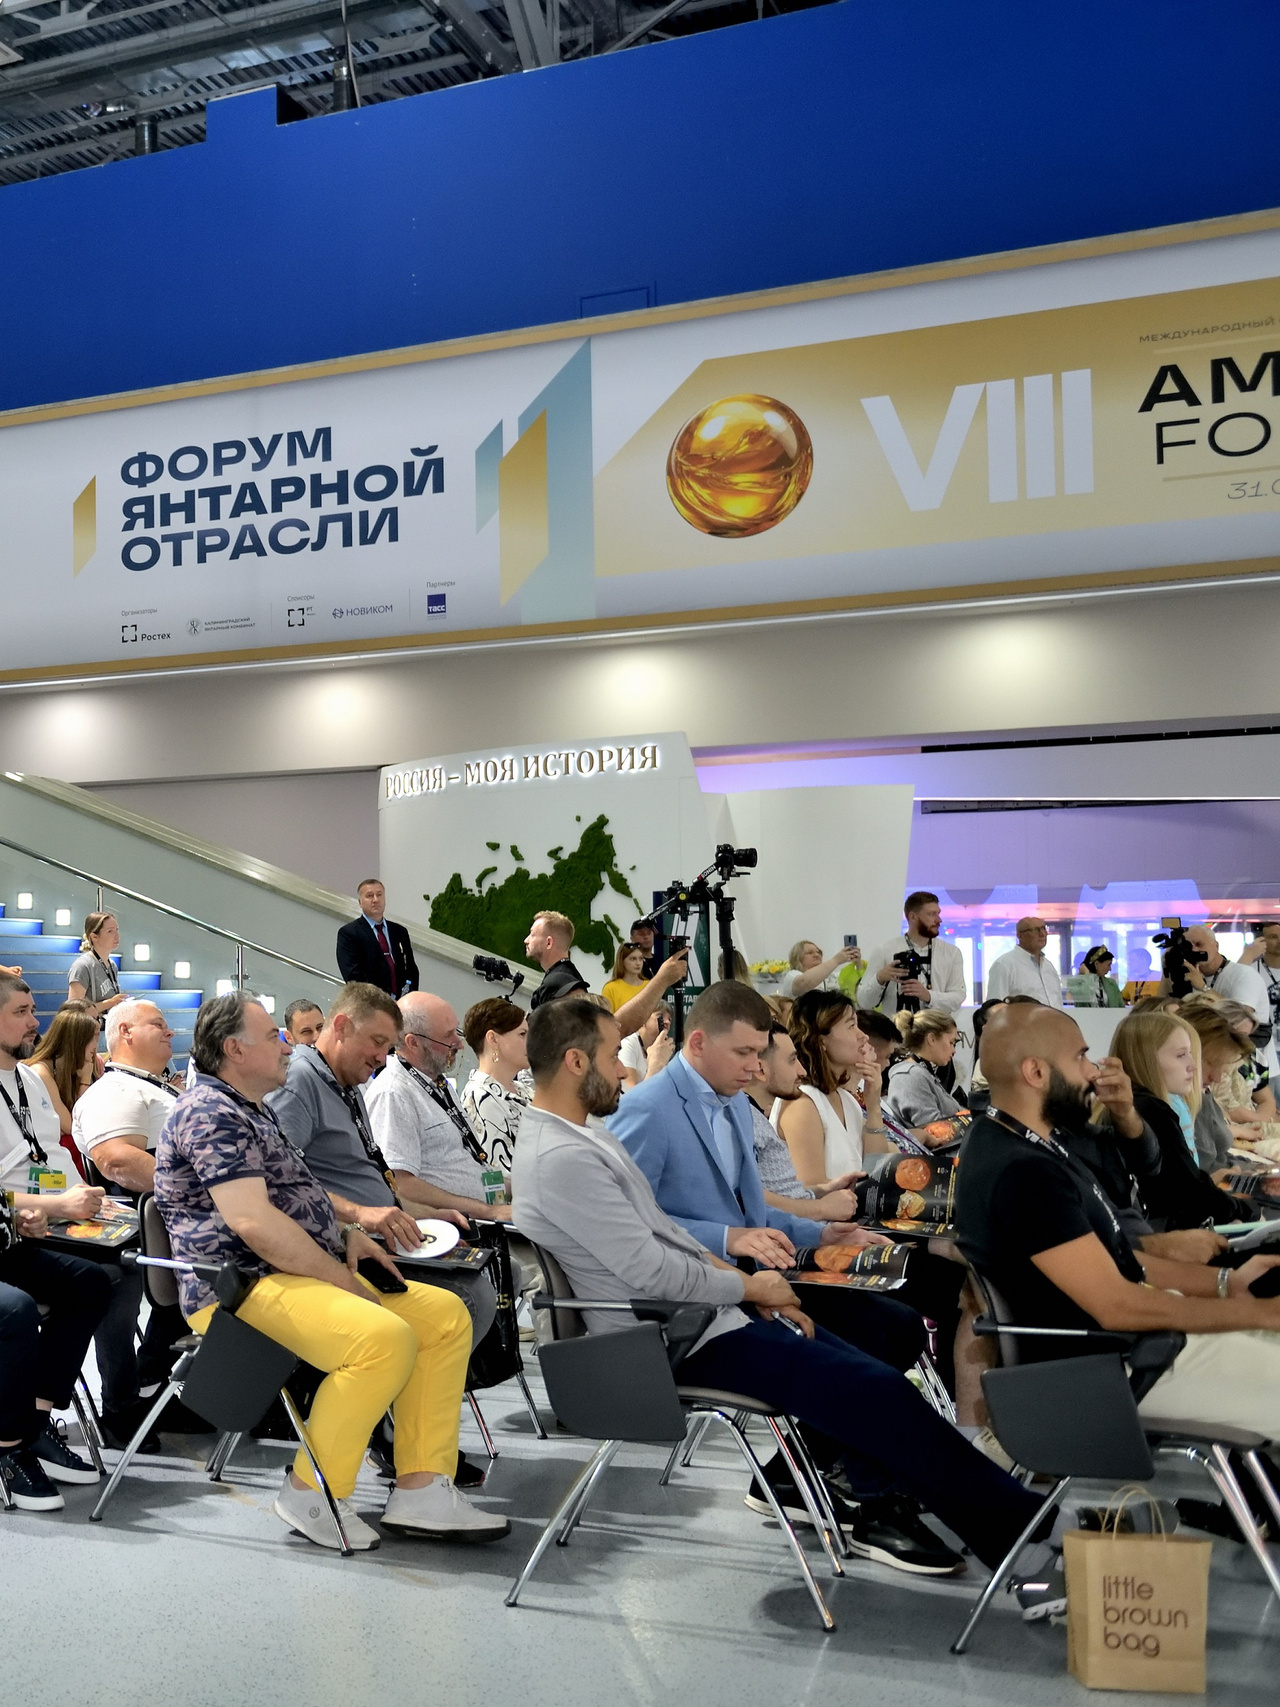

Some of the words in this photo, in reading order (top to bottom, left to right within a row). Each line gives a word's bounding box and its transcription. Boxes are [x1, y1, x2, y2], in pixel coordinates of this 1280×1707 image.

[1139, 316, 1275, 343] МЕЖДУНАРОДНЫЙ
[860, 368, 1095, 512] VIII
[1155, 412, 1271, 465] FO
[120, 426, 332, 488] ФОРУМ
[121, 444, 445, 532] ЯНТАРНОЙ
[121, 506, 399, 571] ОТРАСЛИ
[426, 580, 456, 589] Партнеры
[121, 608, 158, 617] Организаторы
[346, 605, 393, 617] НОВИКОМ
[141, 632, 171, 642] Ростех
[384, 766, 444, 798] РОССИЯ
[464, 757, 515, 786] МОЯ
[522, 744, 659, 779] ИСТОРИЯ
[1102, 1575, 1154, 1601] little
[1103, 1601, 1188, 1628] brown
[1104, 1626, 1161, 1659] bag
